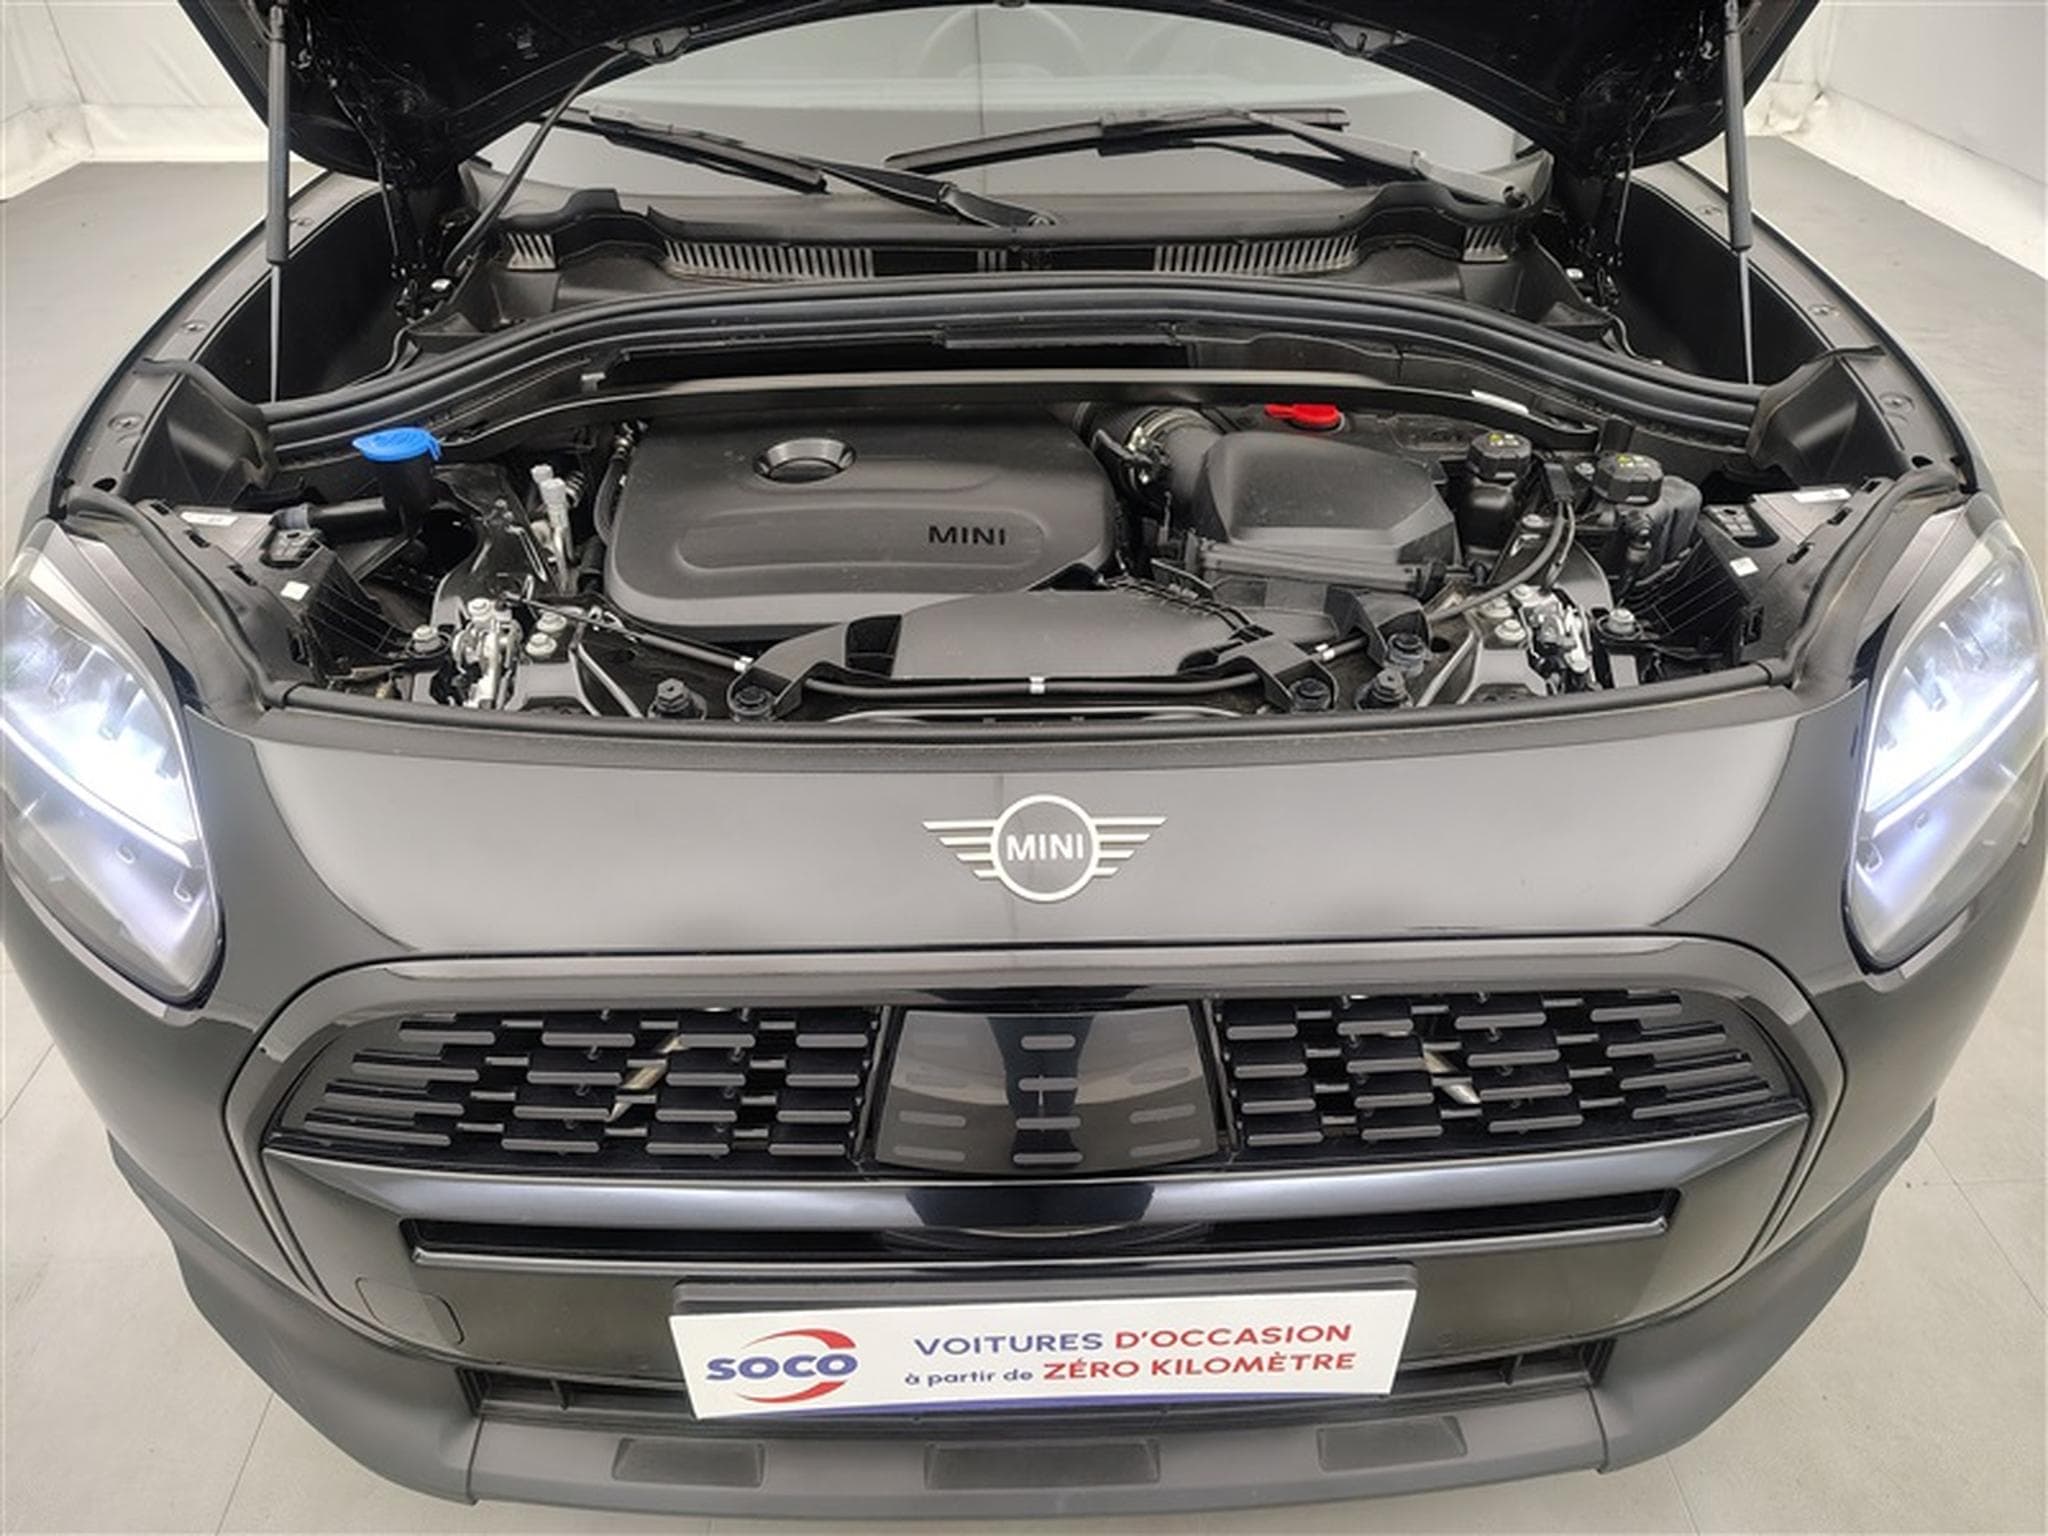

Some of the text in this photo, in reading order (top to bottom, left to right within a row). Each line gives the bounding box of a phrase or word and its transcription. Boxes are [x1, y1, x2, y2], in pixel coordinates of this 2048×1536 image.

[928, 525, 1005, 545] MINI
[1006, 833, 1085, 861] MINI
[914, 1324, 1352, 1356] VOITURES D'OCCASION
[706, 1353, 859, 1381] SOCO
[904, 1351, 1357, 1388] à partir de ZÉRO KILOMÈTRE
